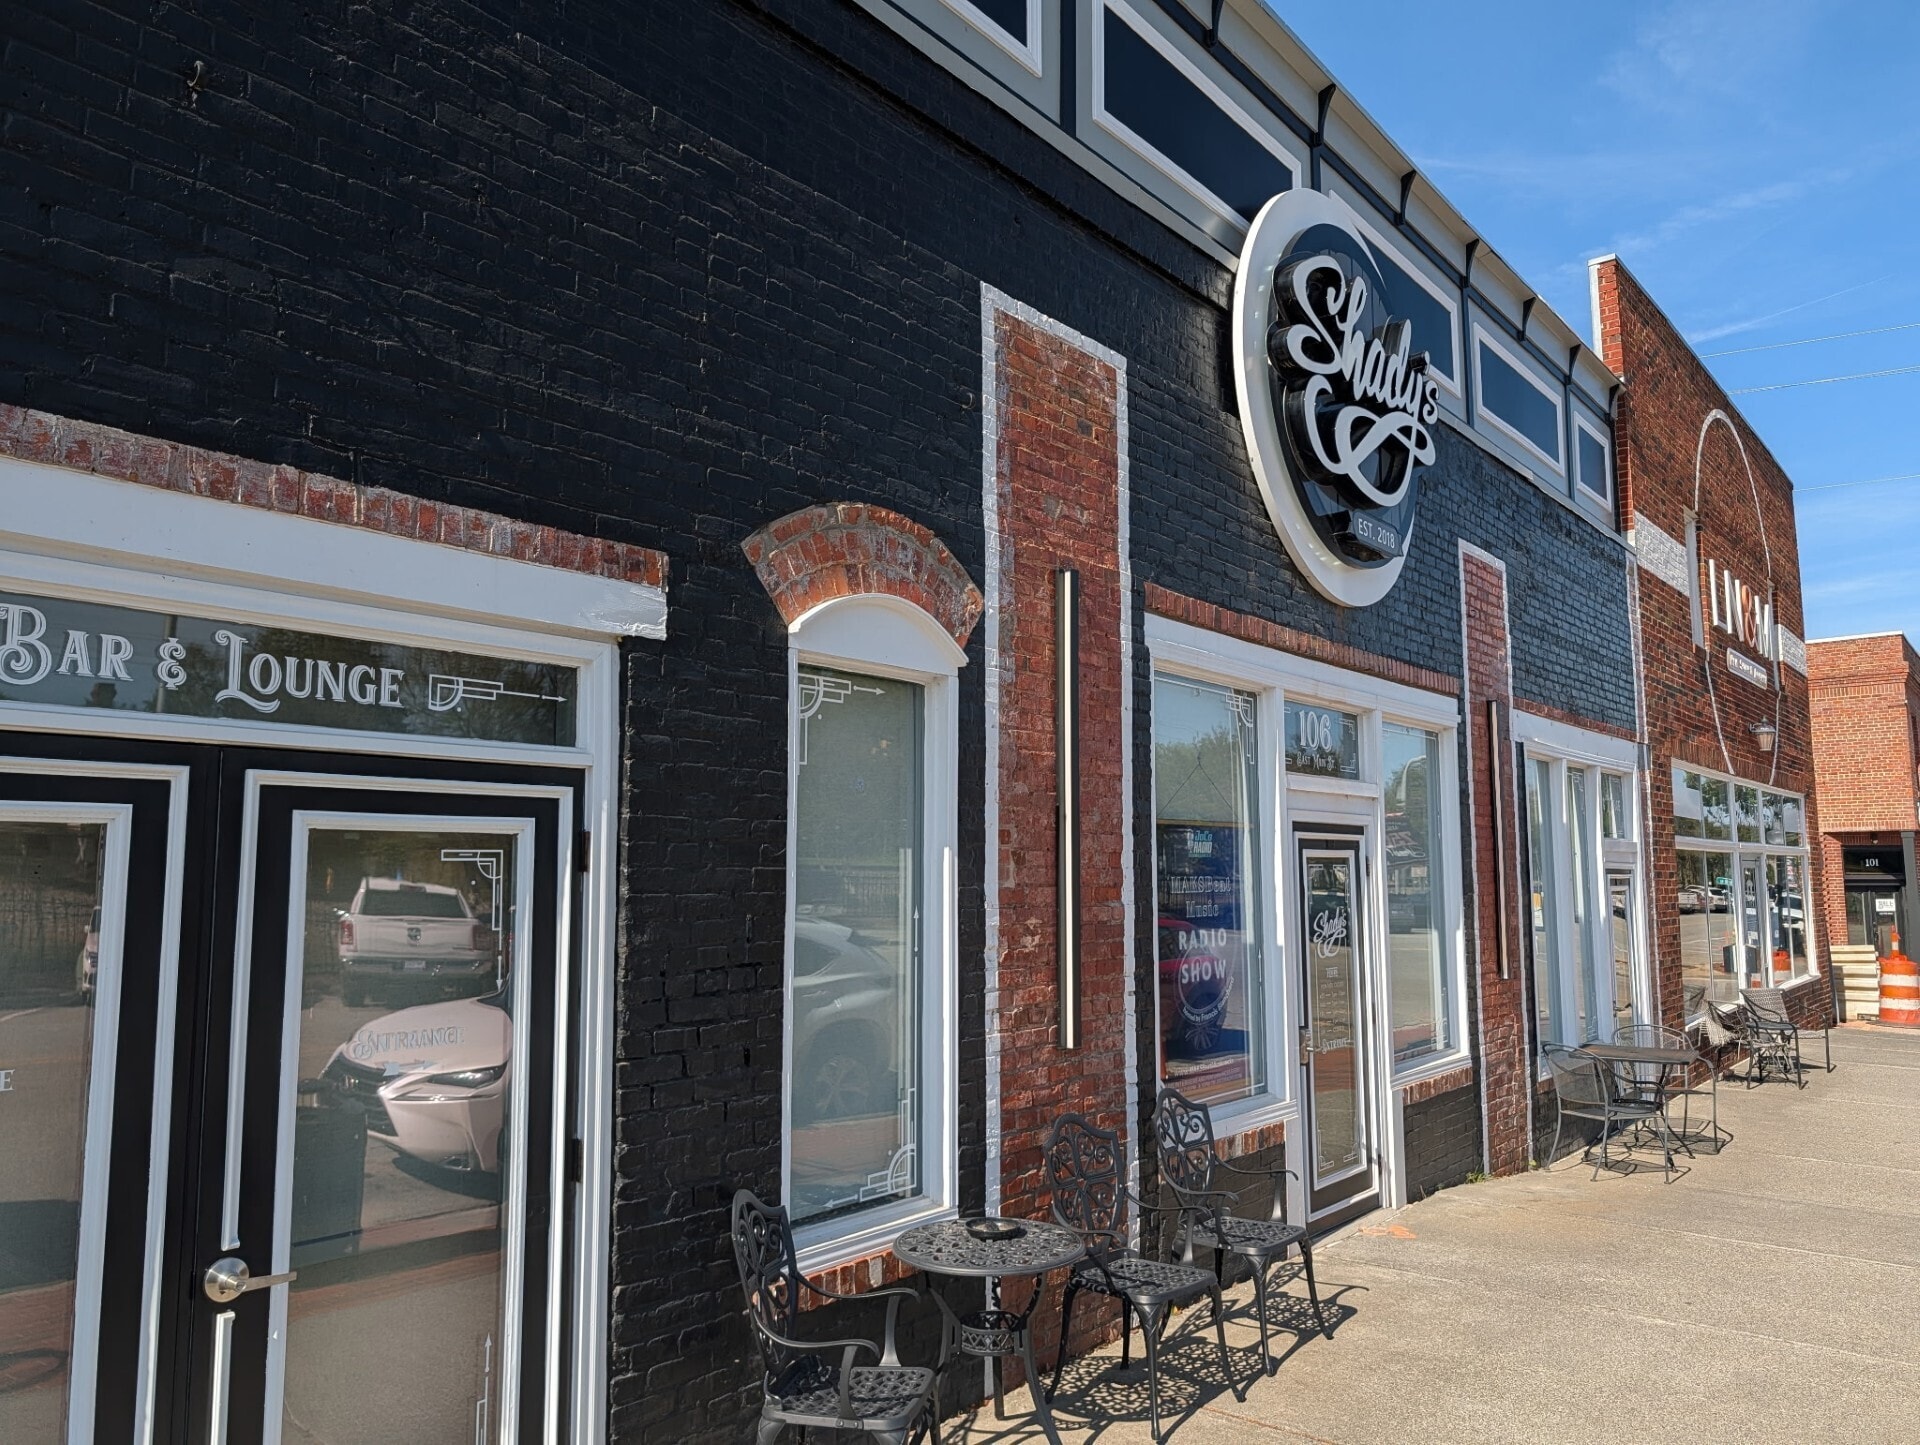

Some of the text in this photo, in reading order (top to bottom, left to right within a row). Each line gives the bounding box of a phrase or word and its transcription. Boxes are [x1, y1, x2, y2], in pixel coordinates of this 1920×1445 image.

[1287, 255, 1439, 506] Shady's
[1358, 518, 1395, 549] EST. 2018
[0, 603, 404, 714] BAR & LOUNGE
[1299, 710, 1332, 753] 106
[1865, 859, 1880, 867] 101
[1178, 928, 1227, 951] RADIO
[1181, 960, 1226, 984] SHOW
[353, 1026, 465, 1059] ENTRANCE
